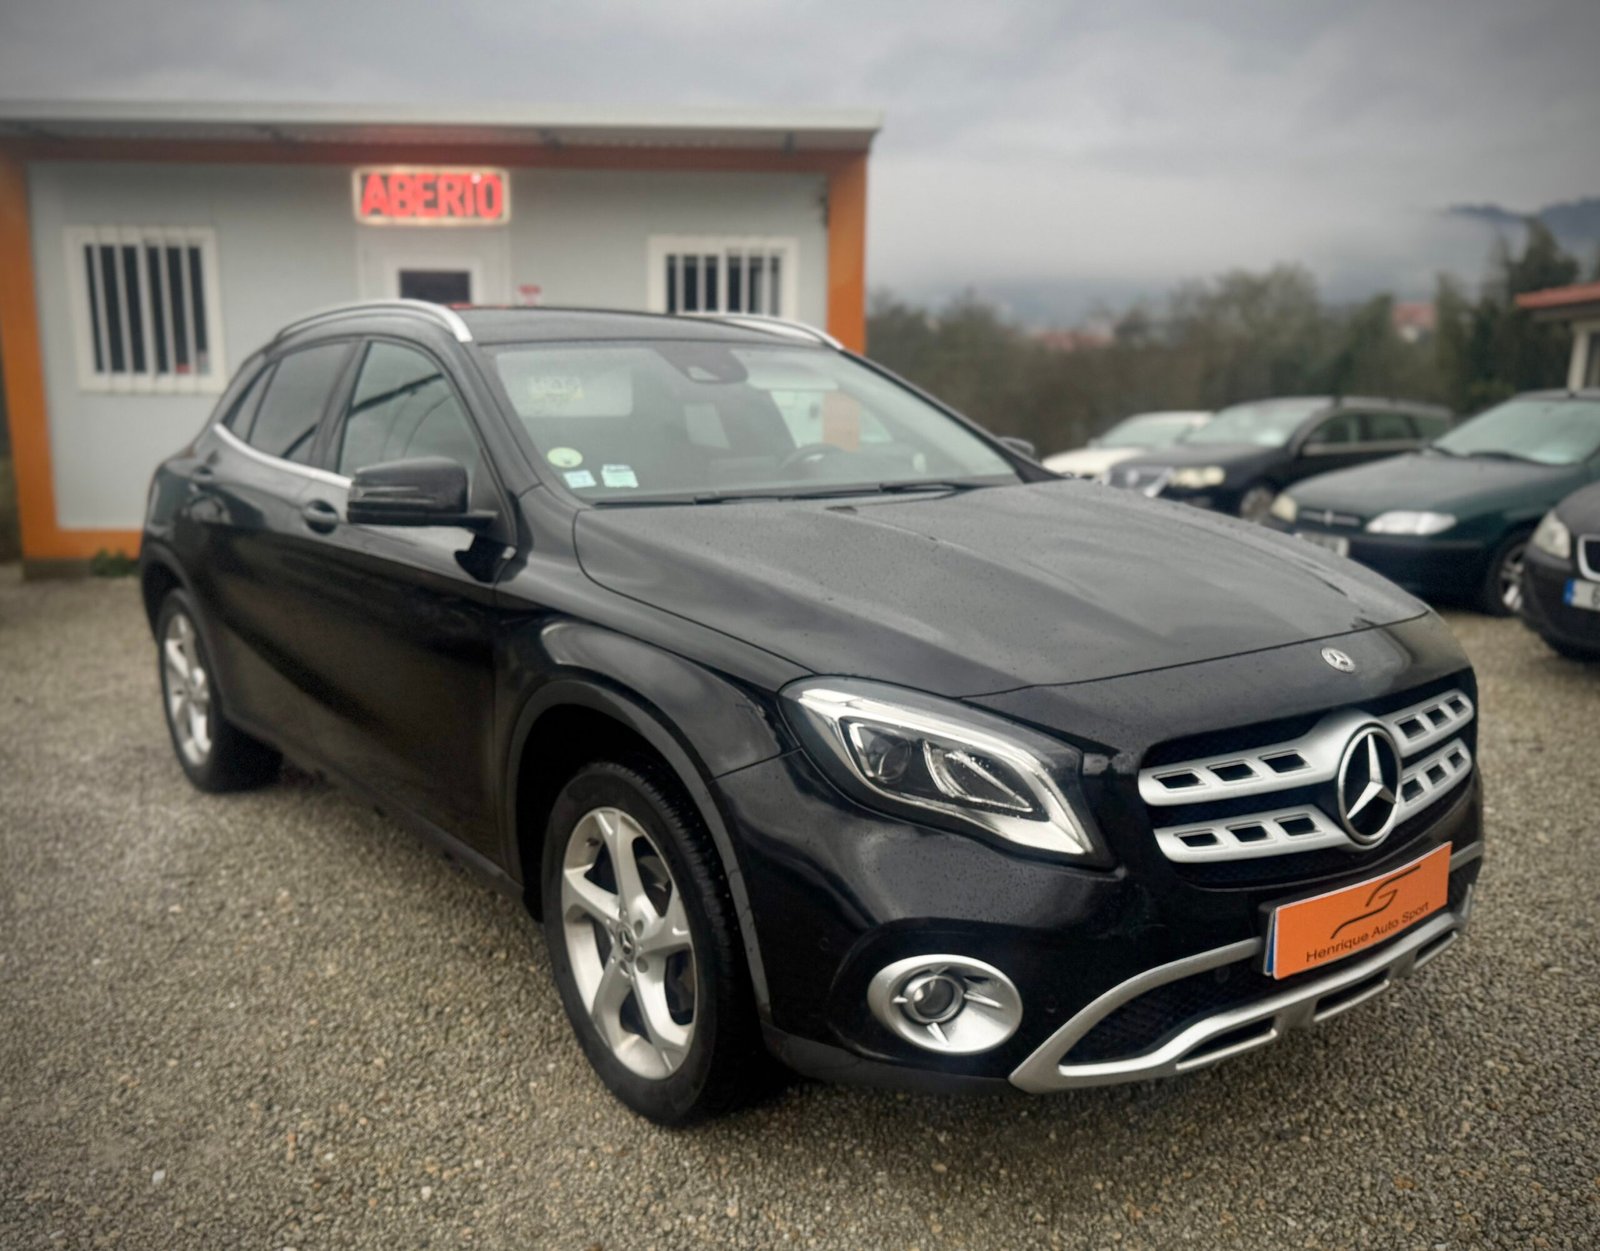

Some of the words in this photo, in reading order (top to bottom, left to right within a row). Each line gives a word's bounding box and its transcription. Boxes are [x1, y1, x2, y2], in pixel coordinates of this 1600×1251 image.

[361, 172, 503, 218] ABERTO
[1306, 932, 1369, 962] Henrique
[1371, 919, 1398, 938] Auto
[1401, 901, 1430, 923] Sport
